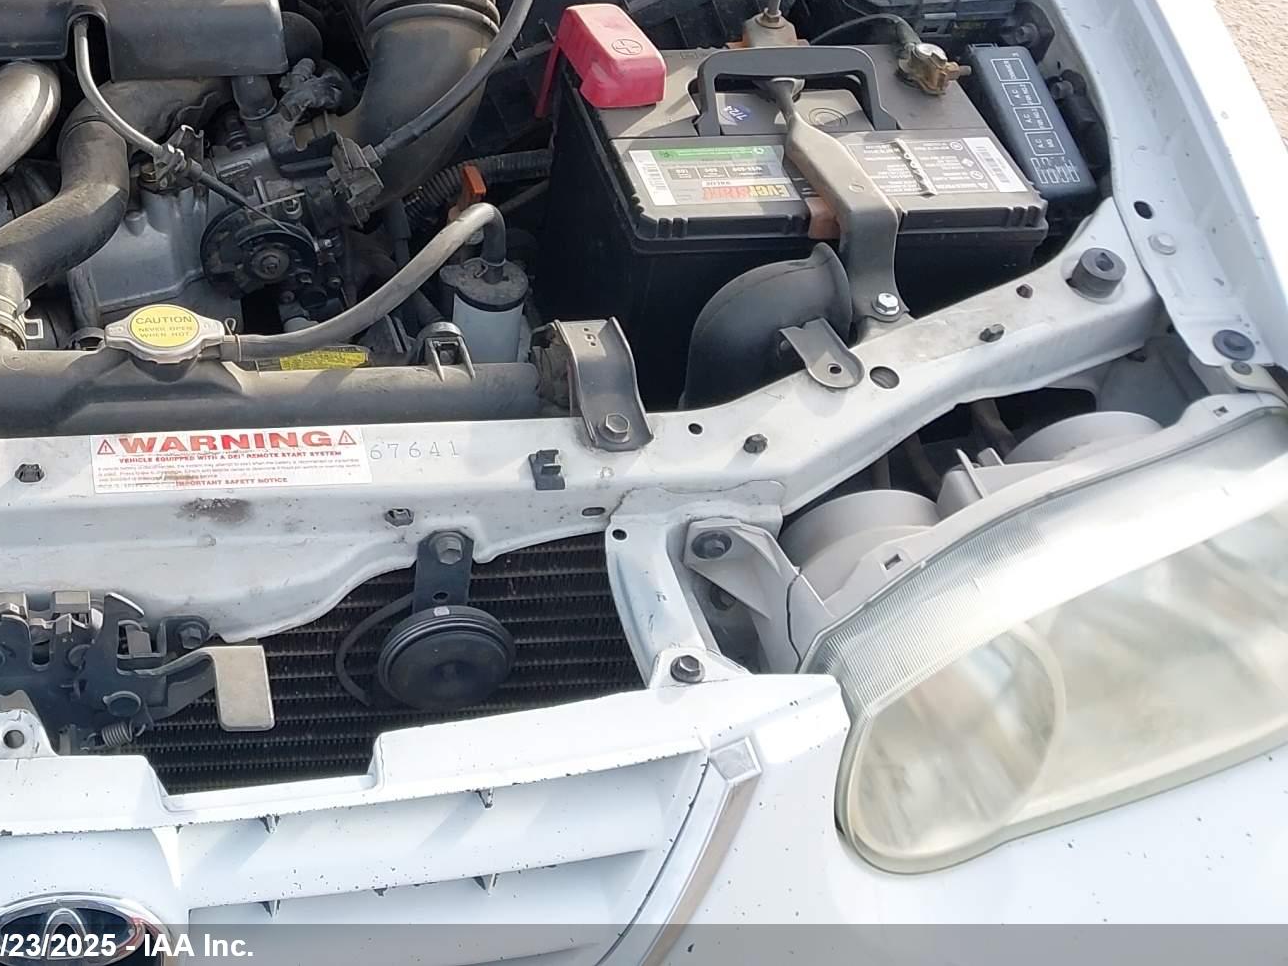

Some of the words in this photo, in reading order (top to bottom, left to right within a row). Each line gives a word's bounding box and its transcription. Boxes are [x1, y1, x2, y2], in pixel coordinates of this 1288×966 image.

[135, 316, 192, 325] CAUTION
[118, 430, 333, 454] WARNING
[369, 440, 460, 460] 67641
[175, 479, 222, 487] IMPORTANT
